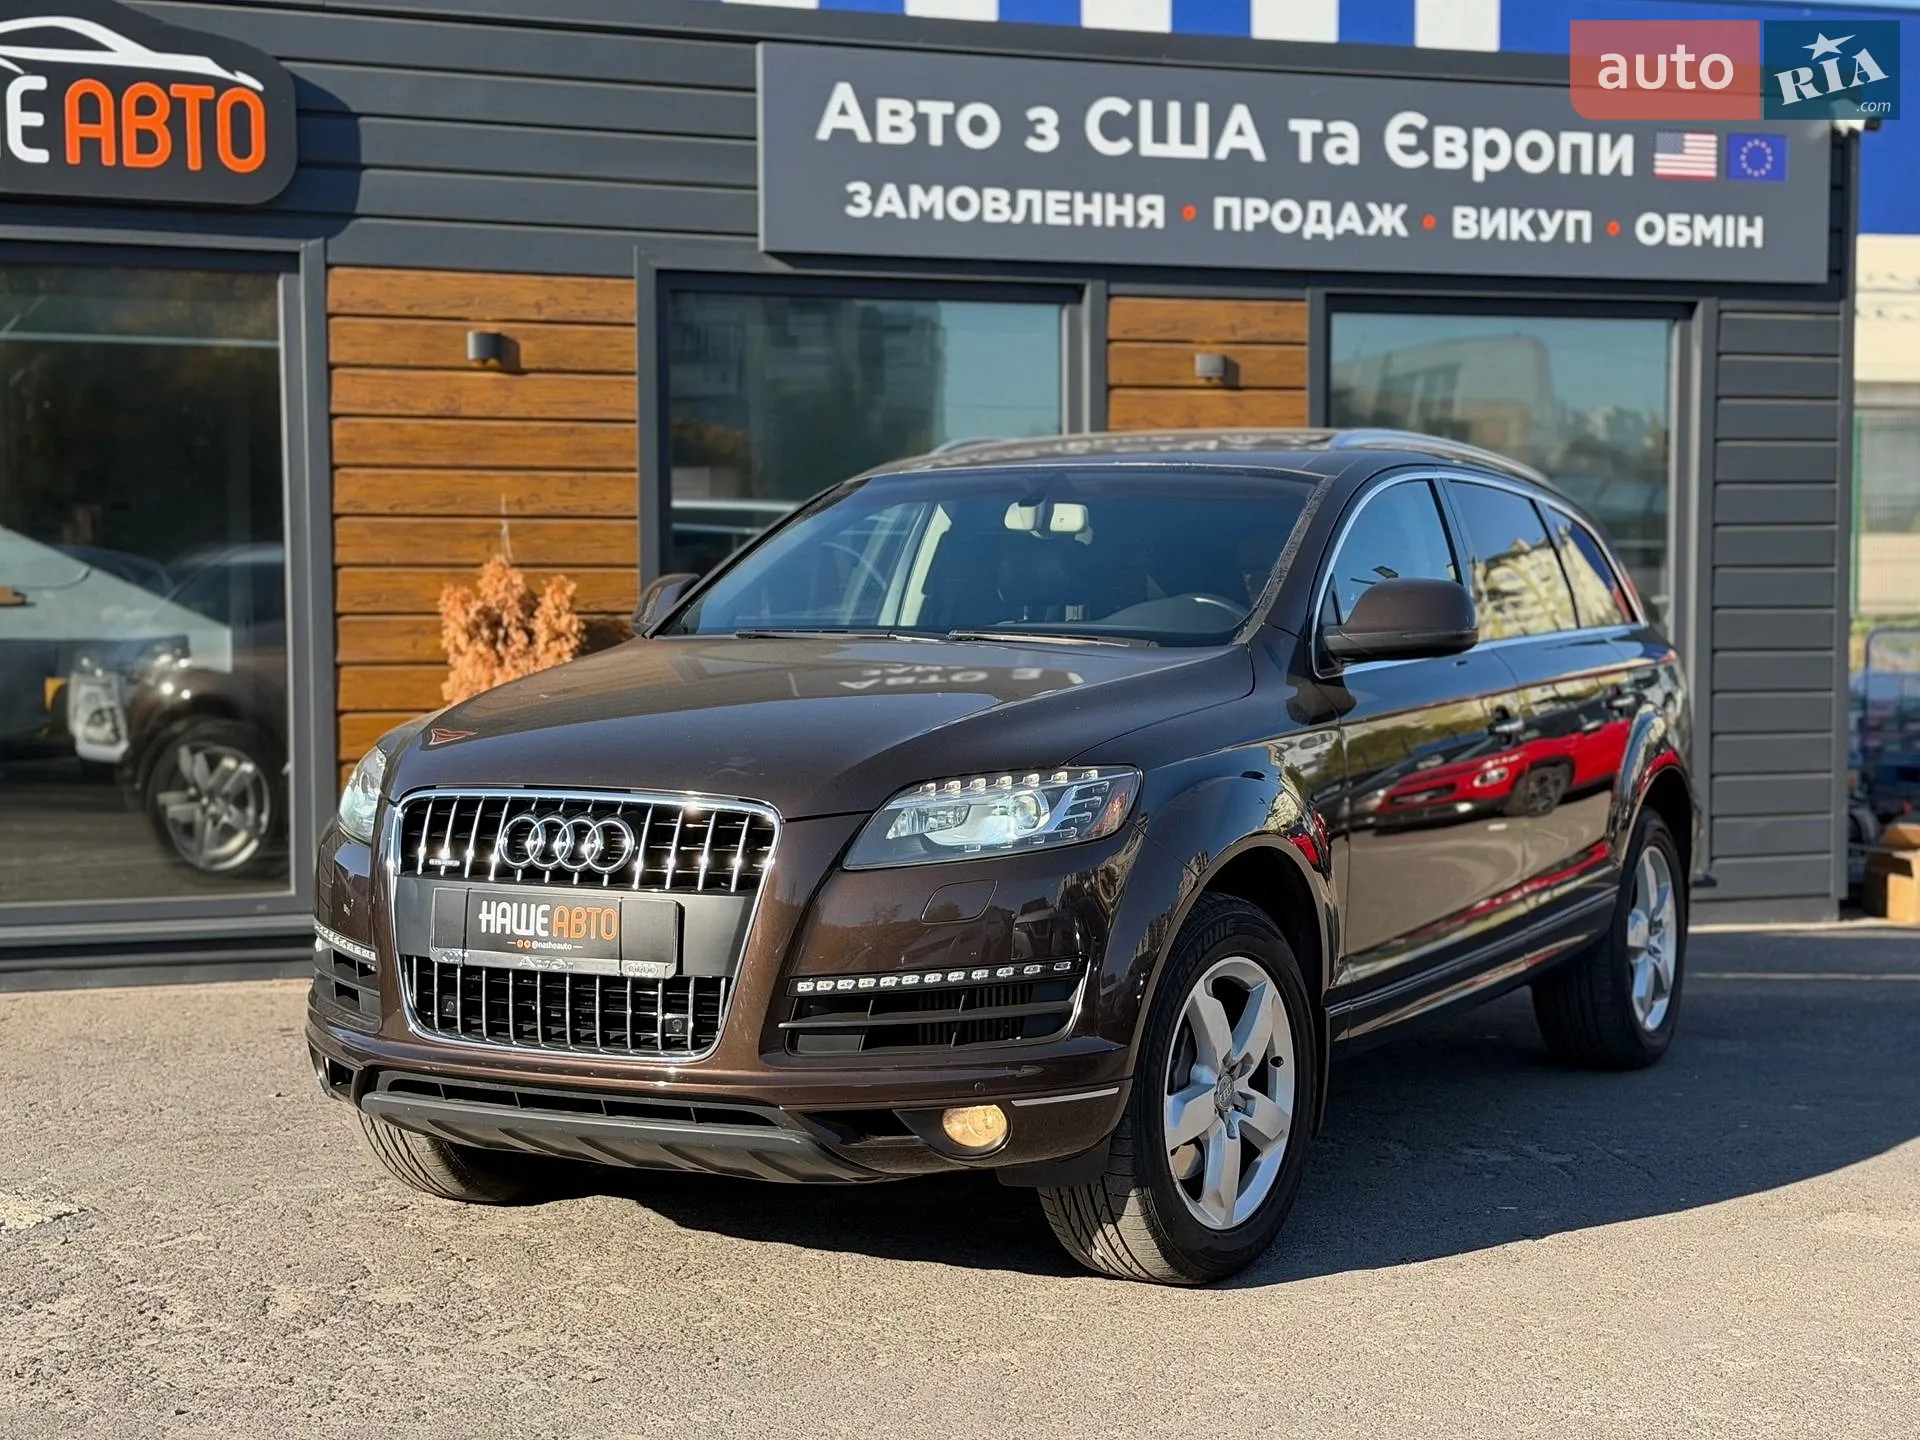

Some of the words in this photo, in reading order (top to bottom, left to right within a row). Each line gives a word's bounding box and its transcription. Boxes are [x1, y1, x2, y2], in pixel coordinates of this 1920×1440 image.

[0, 75, 50, 164] Е
[64, 78, 267, 173] АВТО
[815, 82, 1001, 150] Авто
[1025, 106, 1060, 153] з
[1085, 96, 1266, 162] США
[1288, 118, 1360, 166] та
[1384, 111, 1634, 183] Європи
[845, 181, 1165, 229] ЗАМОВЛЕННЯ
[1213, 196, 1409, 241] ПРОДАЖ
[1452, 205, 1592, 243] ВИКУП
[1635, 212, 1765, 249] ОБМІН
[479, 900, 551, 937] НАШЕ
[552, 905, 619, 941] АВТО
